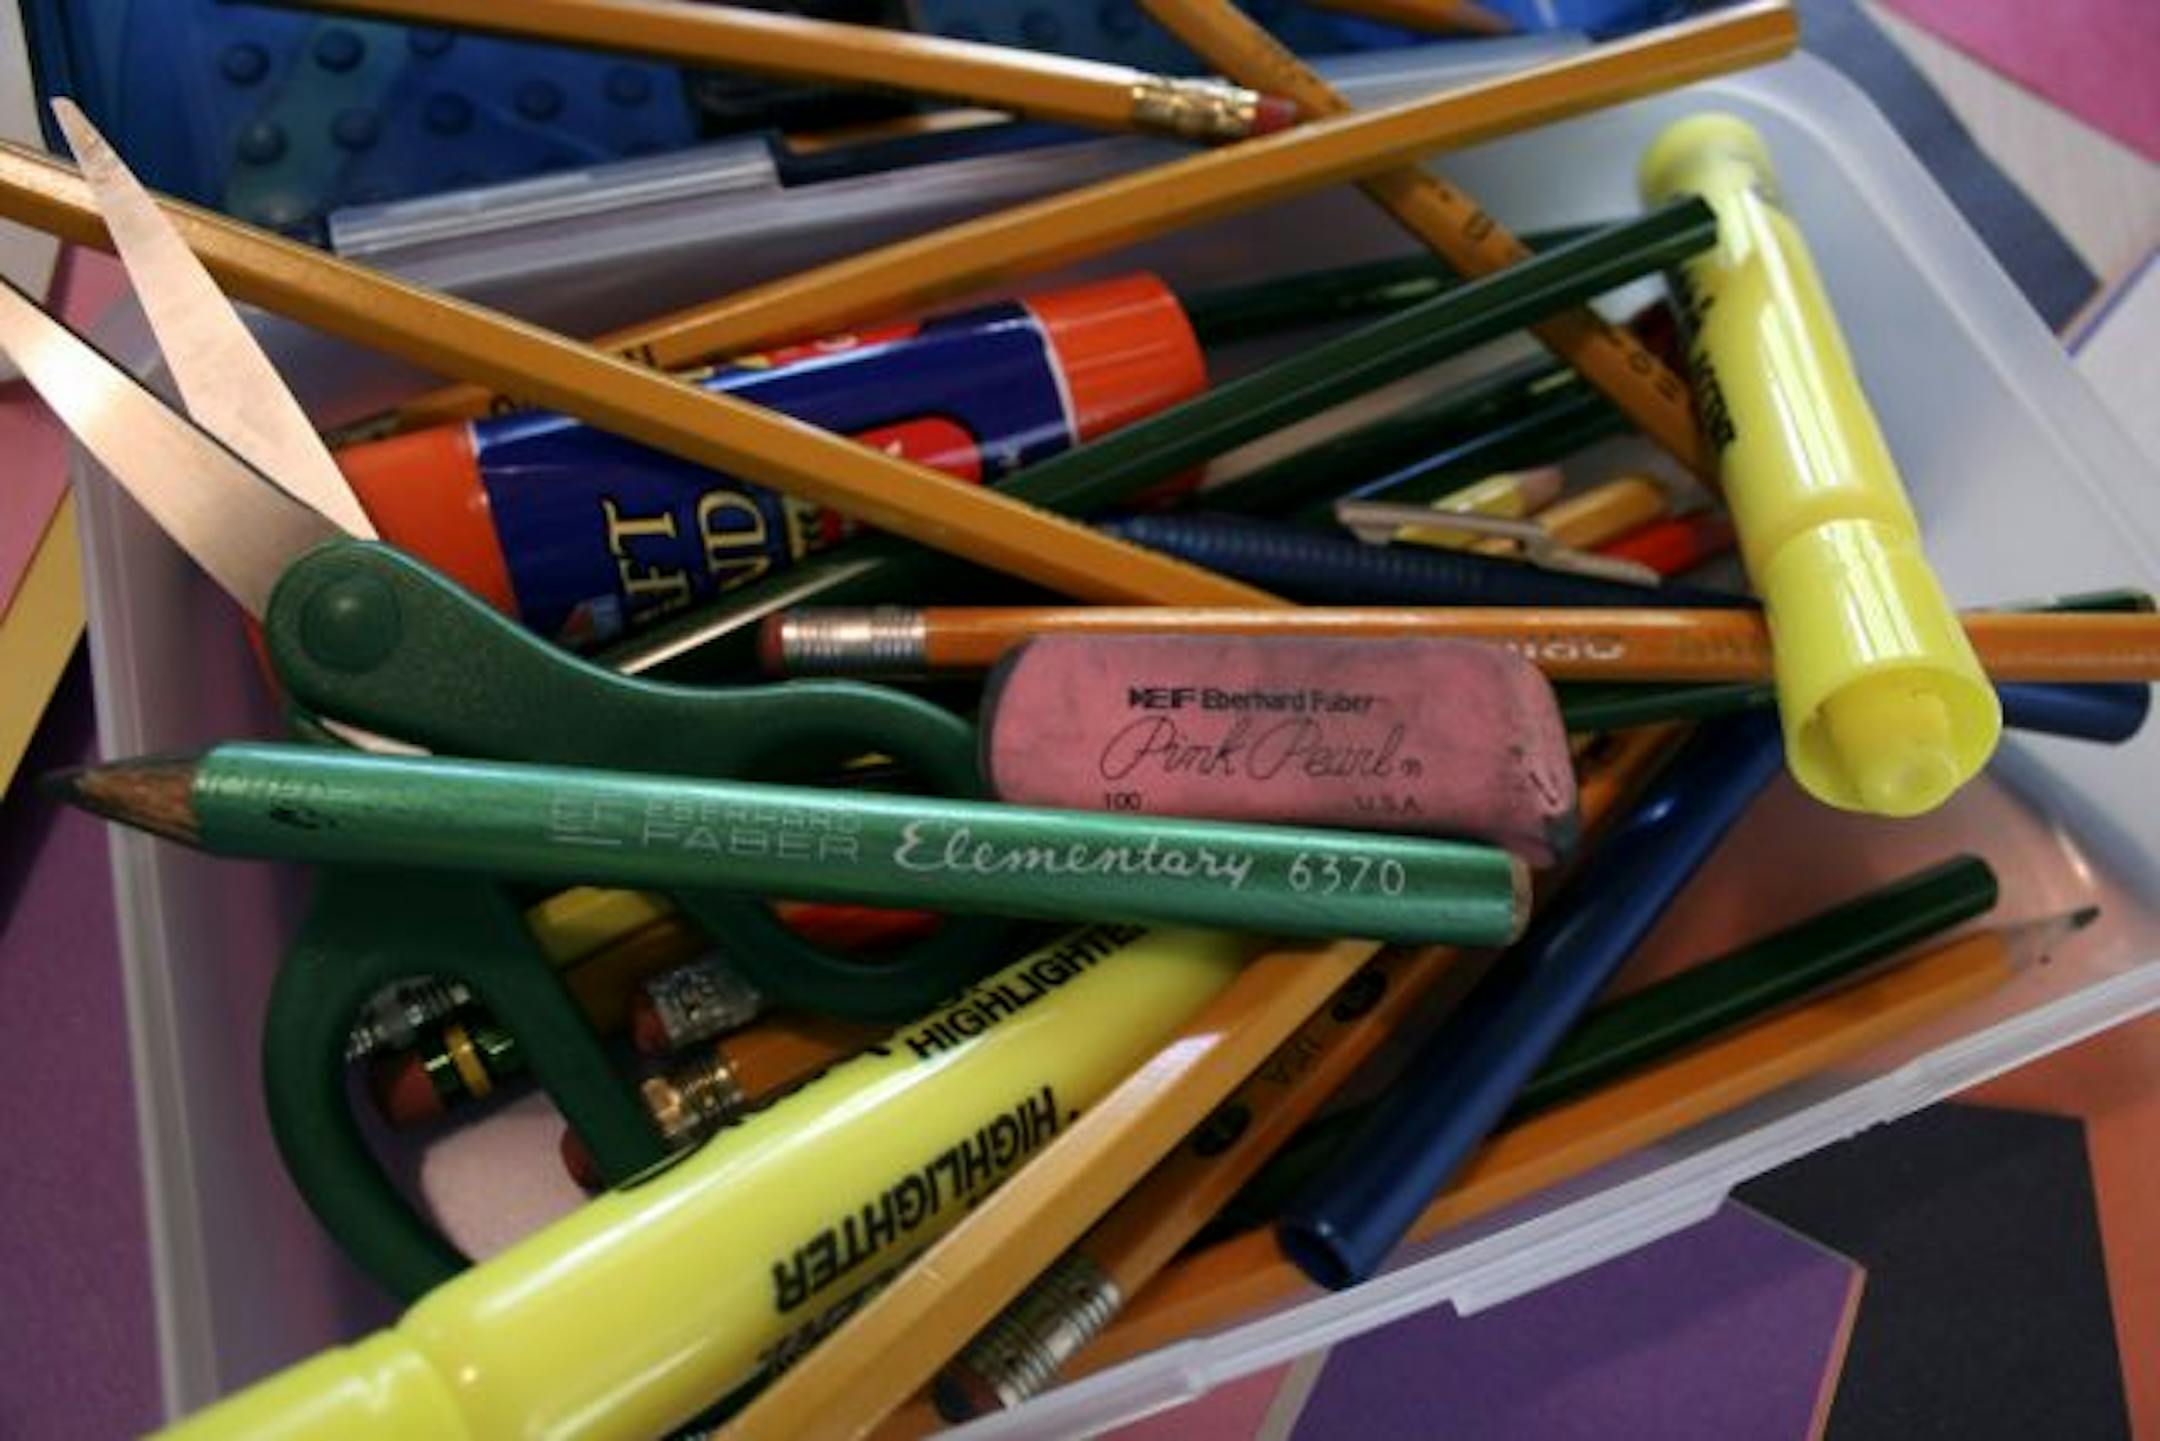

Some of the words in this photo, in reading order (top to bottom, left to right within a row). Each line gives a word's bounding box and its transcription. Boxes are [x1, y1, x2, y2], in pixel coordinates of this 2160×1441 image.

[1201, 687, 1306, 711] Eberhard
[1309, 690, 1374, 713] Faber
[1100, 715, 1247, 781] Pink
[1249, 716, 1405, 781] Pearl
[1105, 793, 1141, 812] 100
[641, 822, 861, 864] FABER
[894, 817, 1254, 888] Elementary
[1289, 851, 1405, 896] 6370
[771, 1085, 1058, 1313] HIGHLIGHTER
